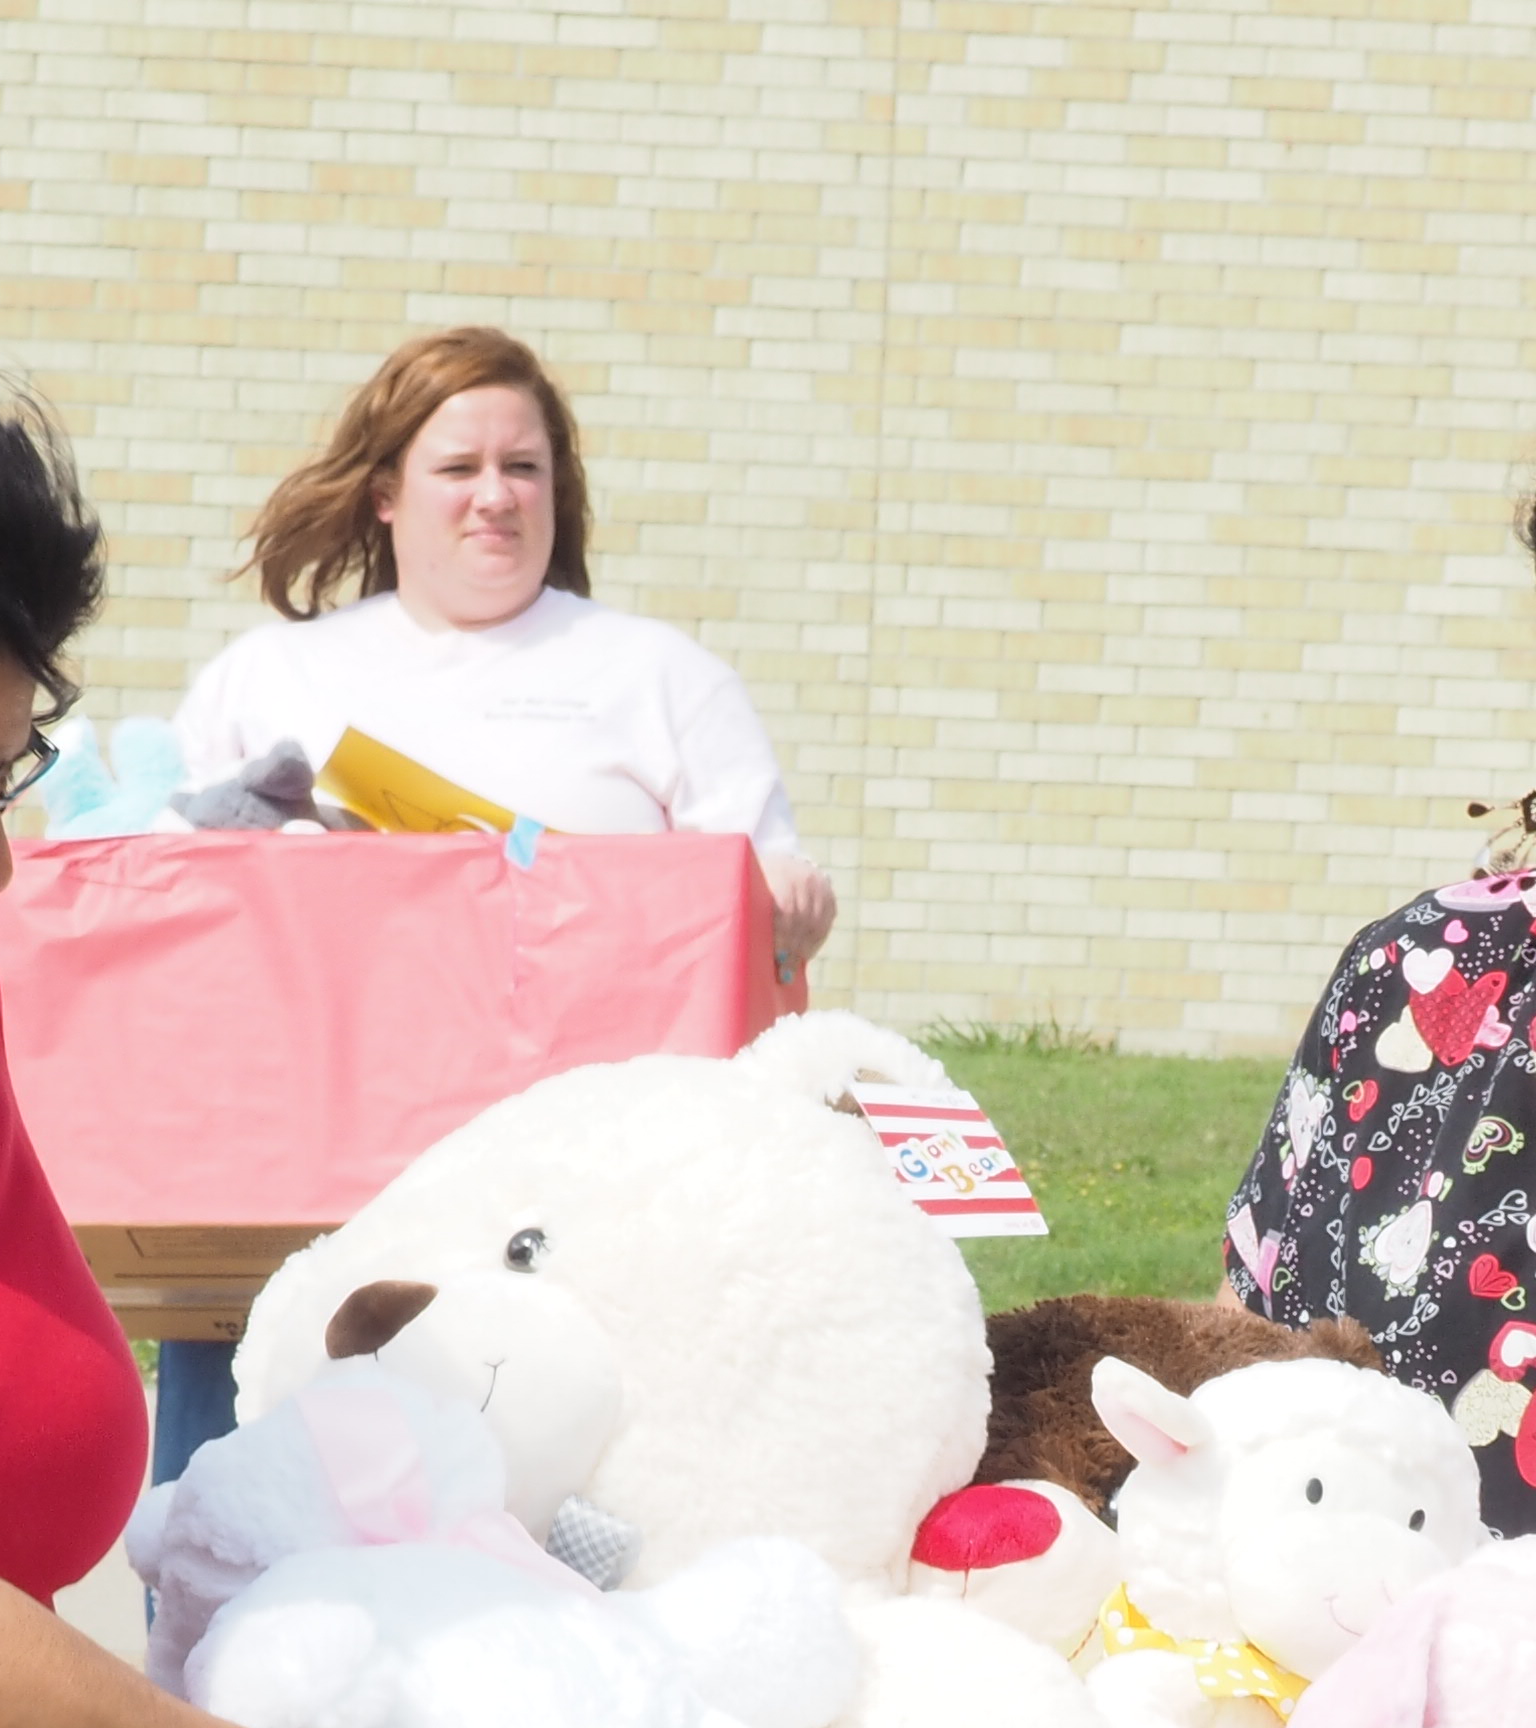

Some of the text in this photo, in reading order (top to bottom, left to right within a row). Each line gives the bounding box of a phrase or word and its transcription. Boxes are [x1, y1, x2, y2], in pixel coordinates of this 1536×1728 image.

[1358, 934, 1416, 976] LOVE
[898, 1129, 963, 1180] Giant
[941, 1149, 1004, 1194] Bear
